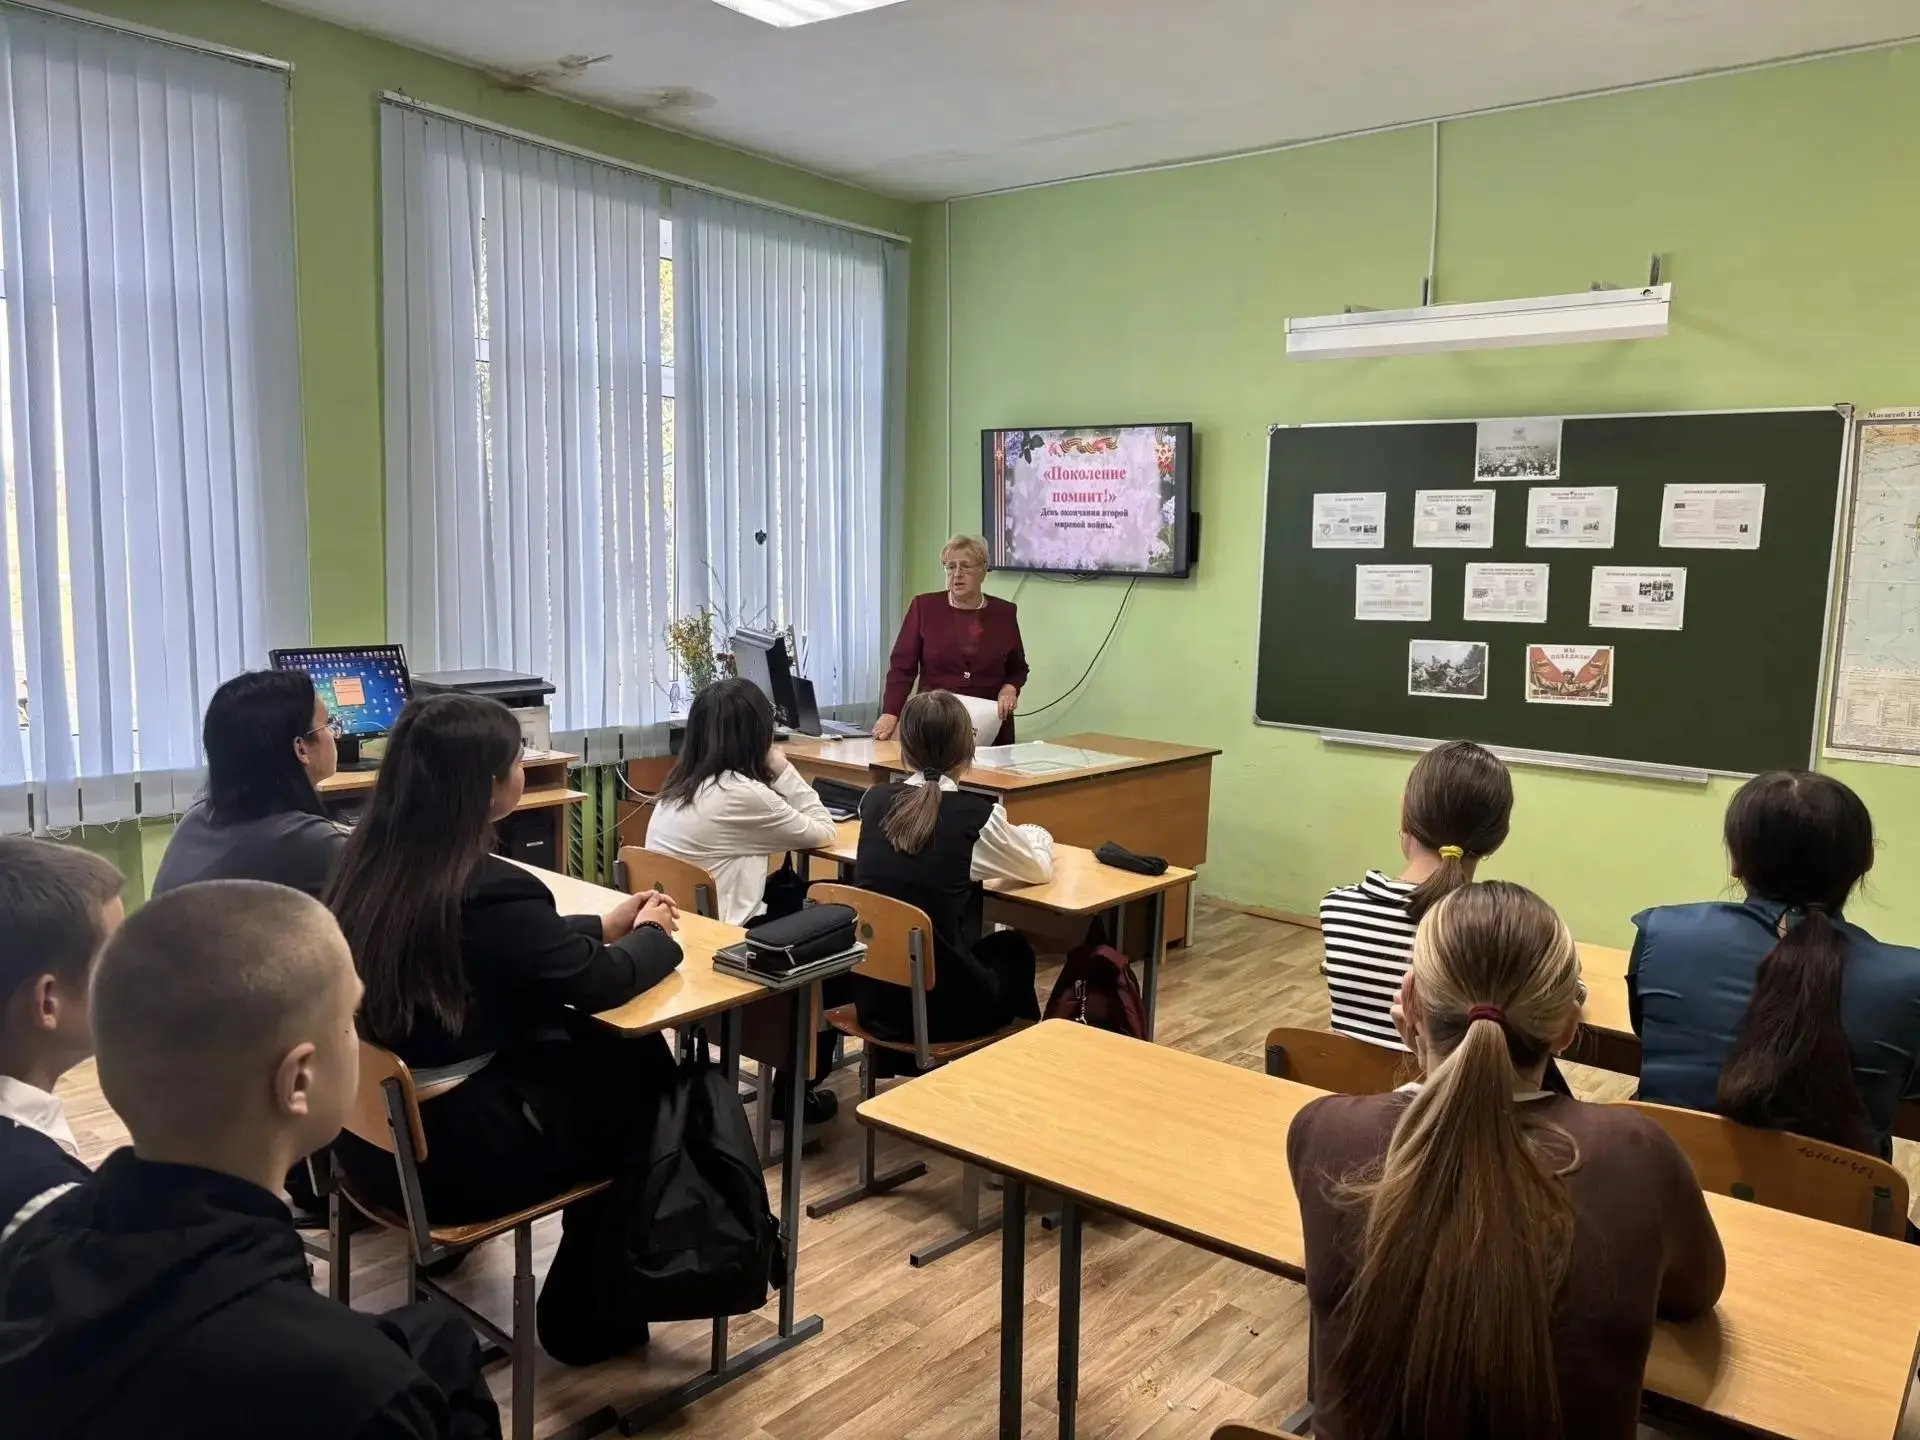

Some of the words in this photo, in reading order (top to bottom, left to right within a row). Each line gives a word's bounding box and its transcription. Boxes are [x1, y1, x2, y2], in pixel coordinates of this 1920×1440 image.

[1043, 466, 1127, 481] «Поколение
[1052, 488, 1117, 503] помнит!»
[1040, 508, 1059, 518] День
[1060, 509, 1100, 517] окончания
[1101, 508, 1129, 519] второй
[1054, 521, 1086, 530] мировой
[1087, 521, 1115, 530] войны.
